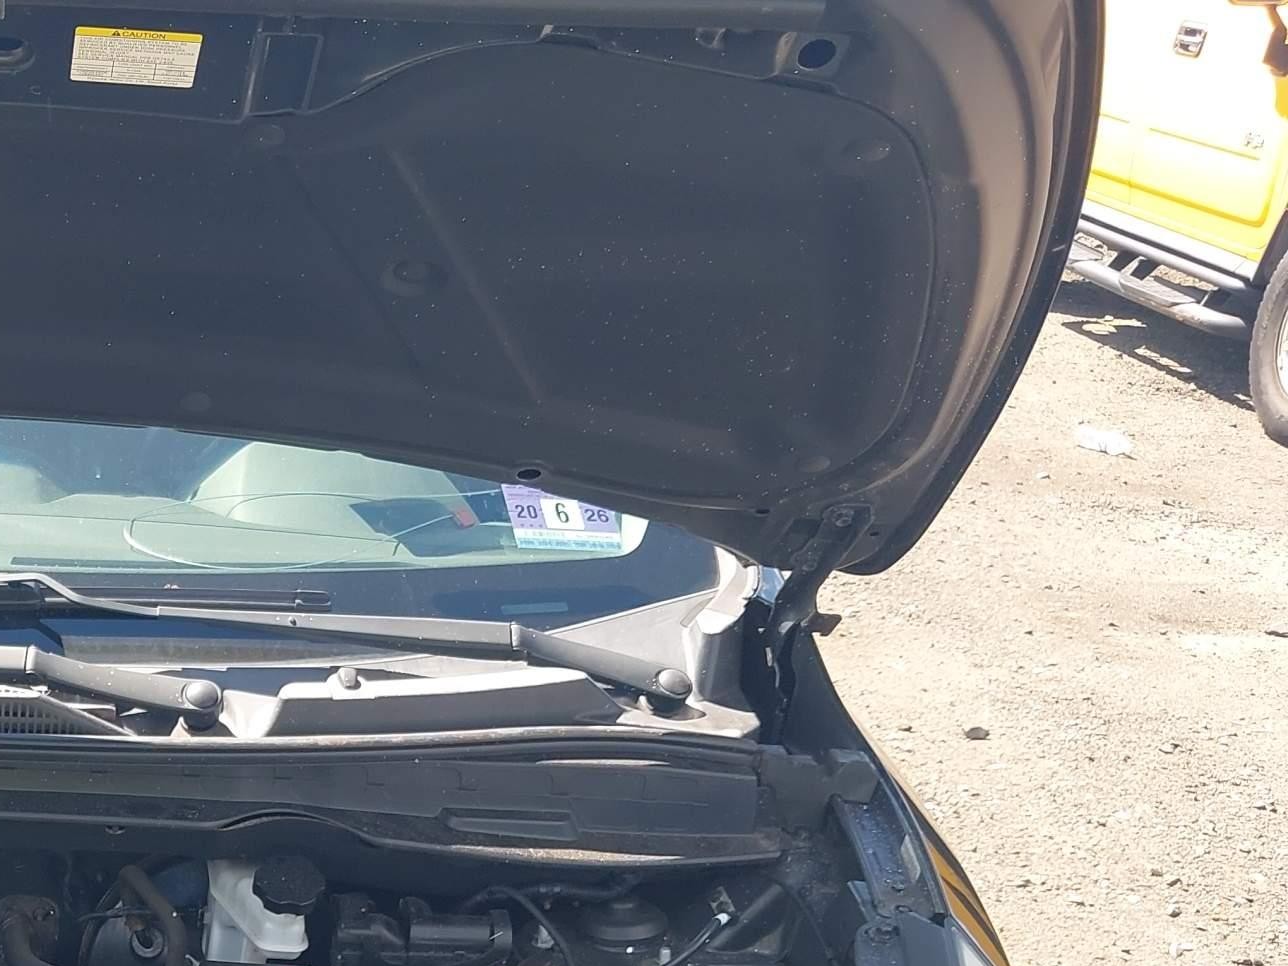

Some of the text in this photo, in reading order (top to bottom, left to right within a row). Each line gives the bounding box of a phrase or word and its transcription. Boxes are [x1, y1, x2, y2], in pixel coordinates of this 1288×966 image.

[122, 31, 167, 40] CAUTION
[514, 502, 609, 523] 20 6 26
